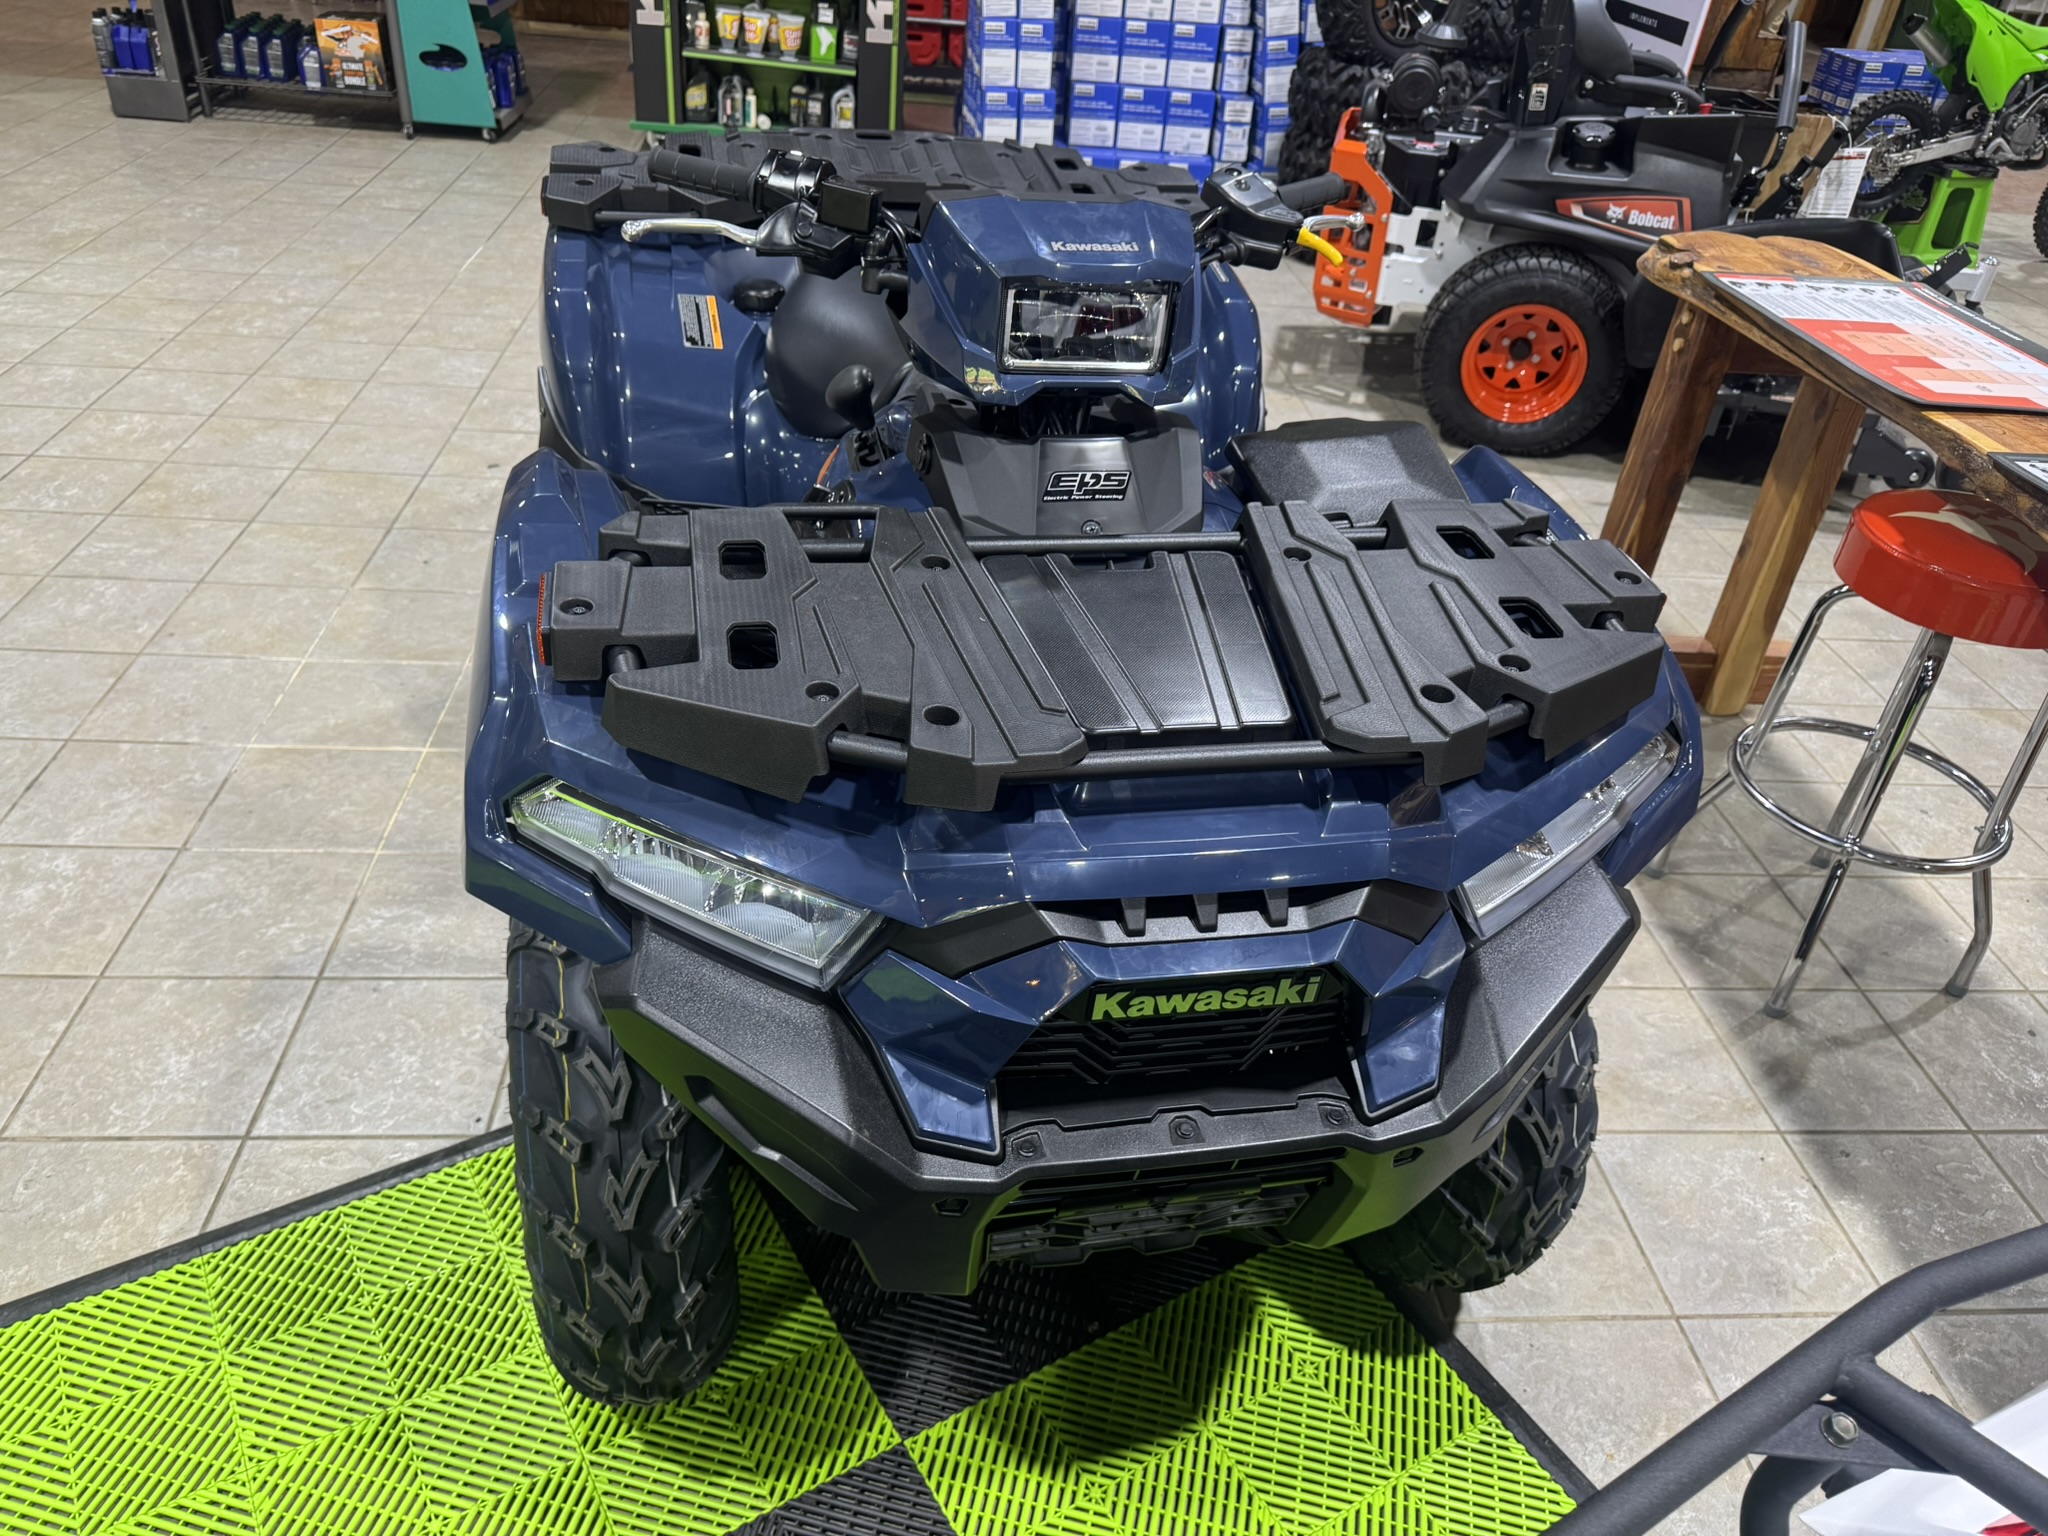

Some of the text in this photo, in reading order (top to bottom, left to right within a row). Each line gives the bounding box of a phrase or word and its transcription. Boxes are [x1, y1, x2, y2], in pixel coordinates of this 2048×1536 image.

[1627, 208, 1676, 230] Bobcat
[1050, 241, 1140, 252] Kawasaki
[1047, 471, 1130, 495] EPS
[1091, 976, 1321, 1020] Kawasaki
